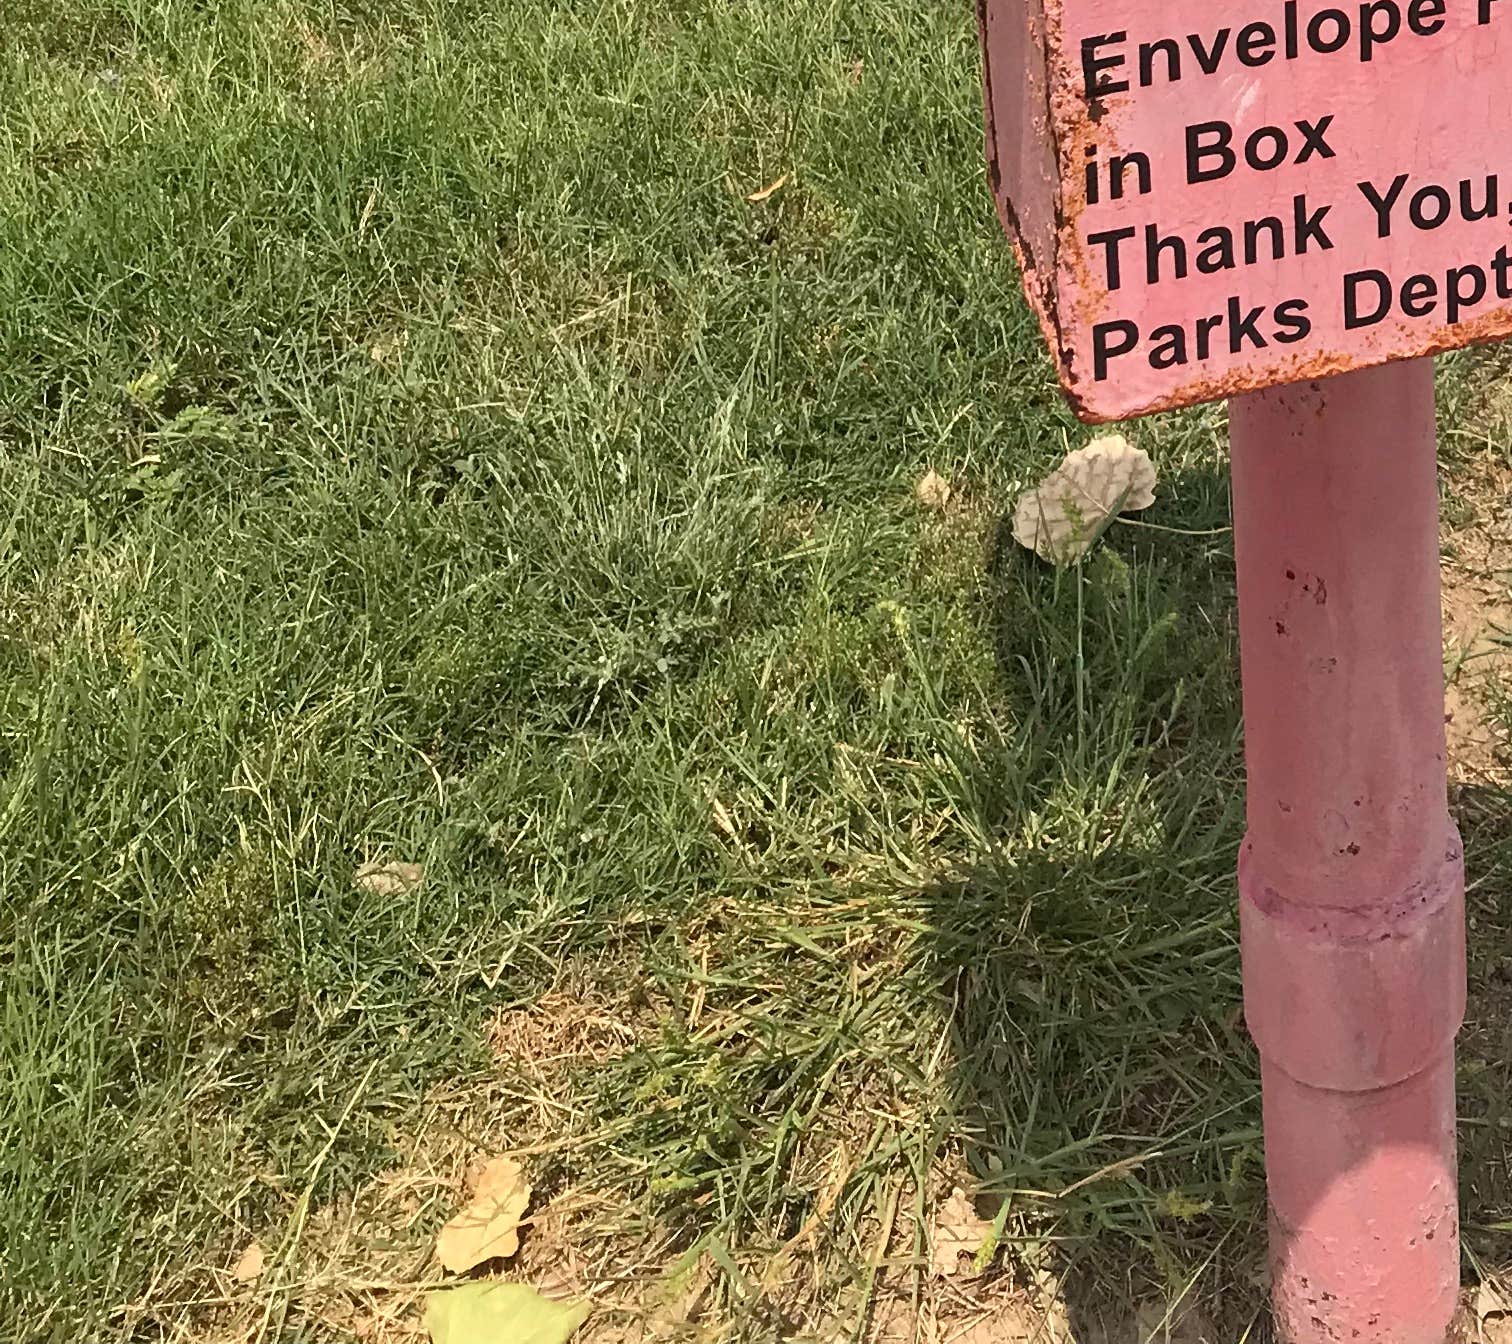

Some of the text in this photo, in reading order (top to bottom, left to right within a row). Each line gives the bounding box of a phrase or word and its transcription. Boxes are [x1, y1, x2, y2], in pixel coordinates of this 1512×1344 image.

[1085, 113, 1337, 205] in Box
[1088, 195, 1335, 291] Thank
[1092, 295, 1312, 382] Parks
